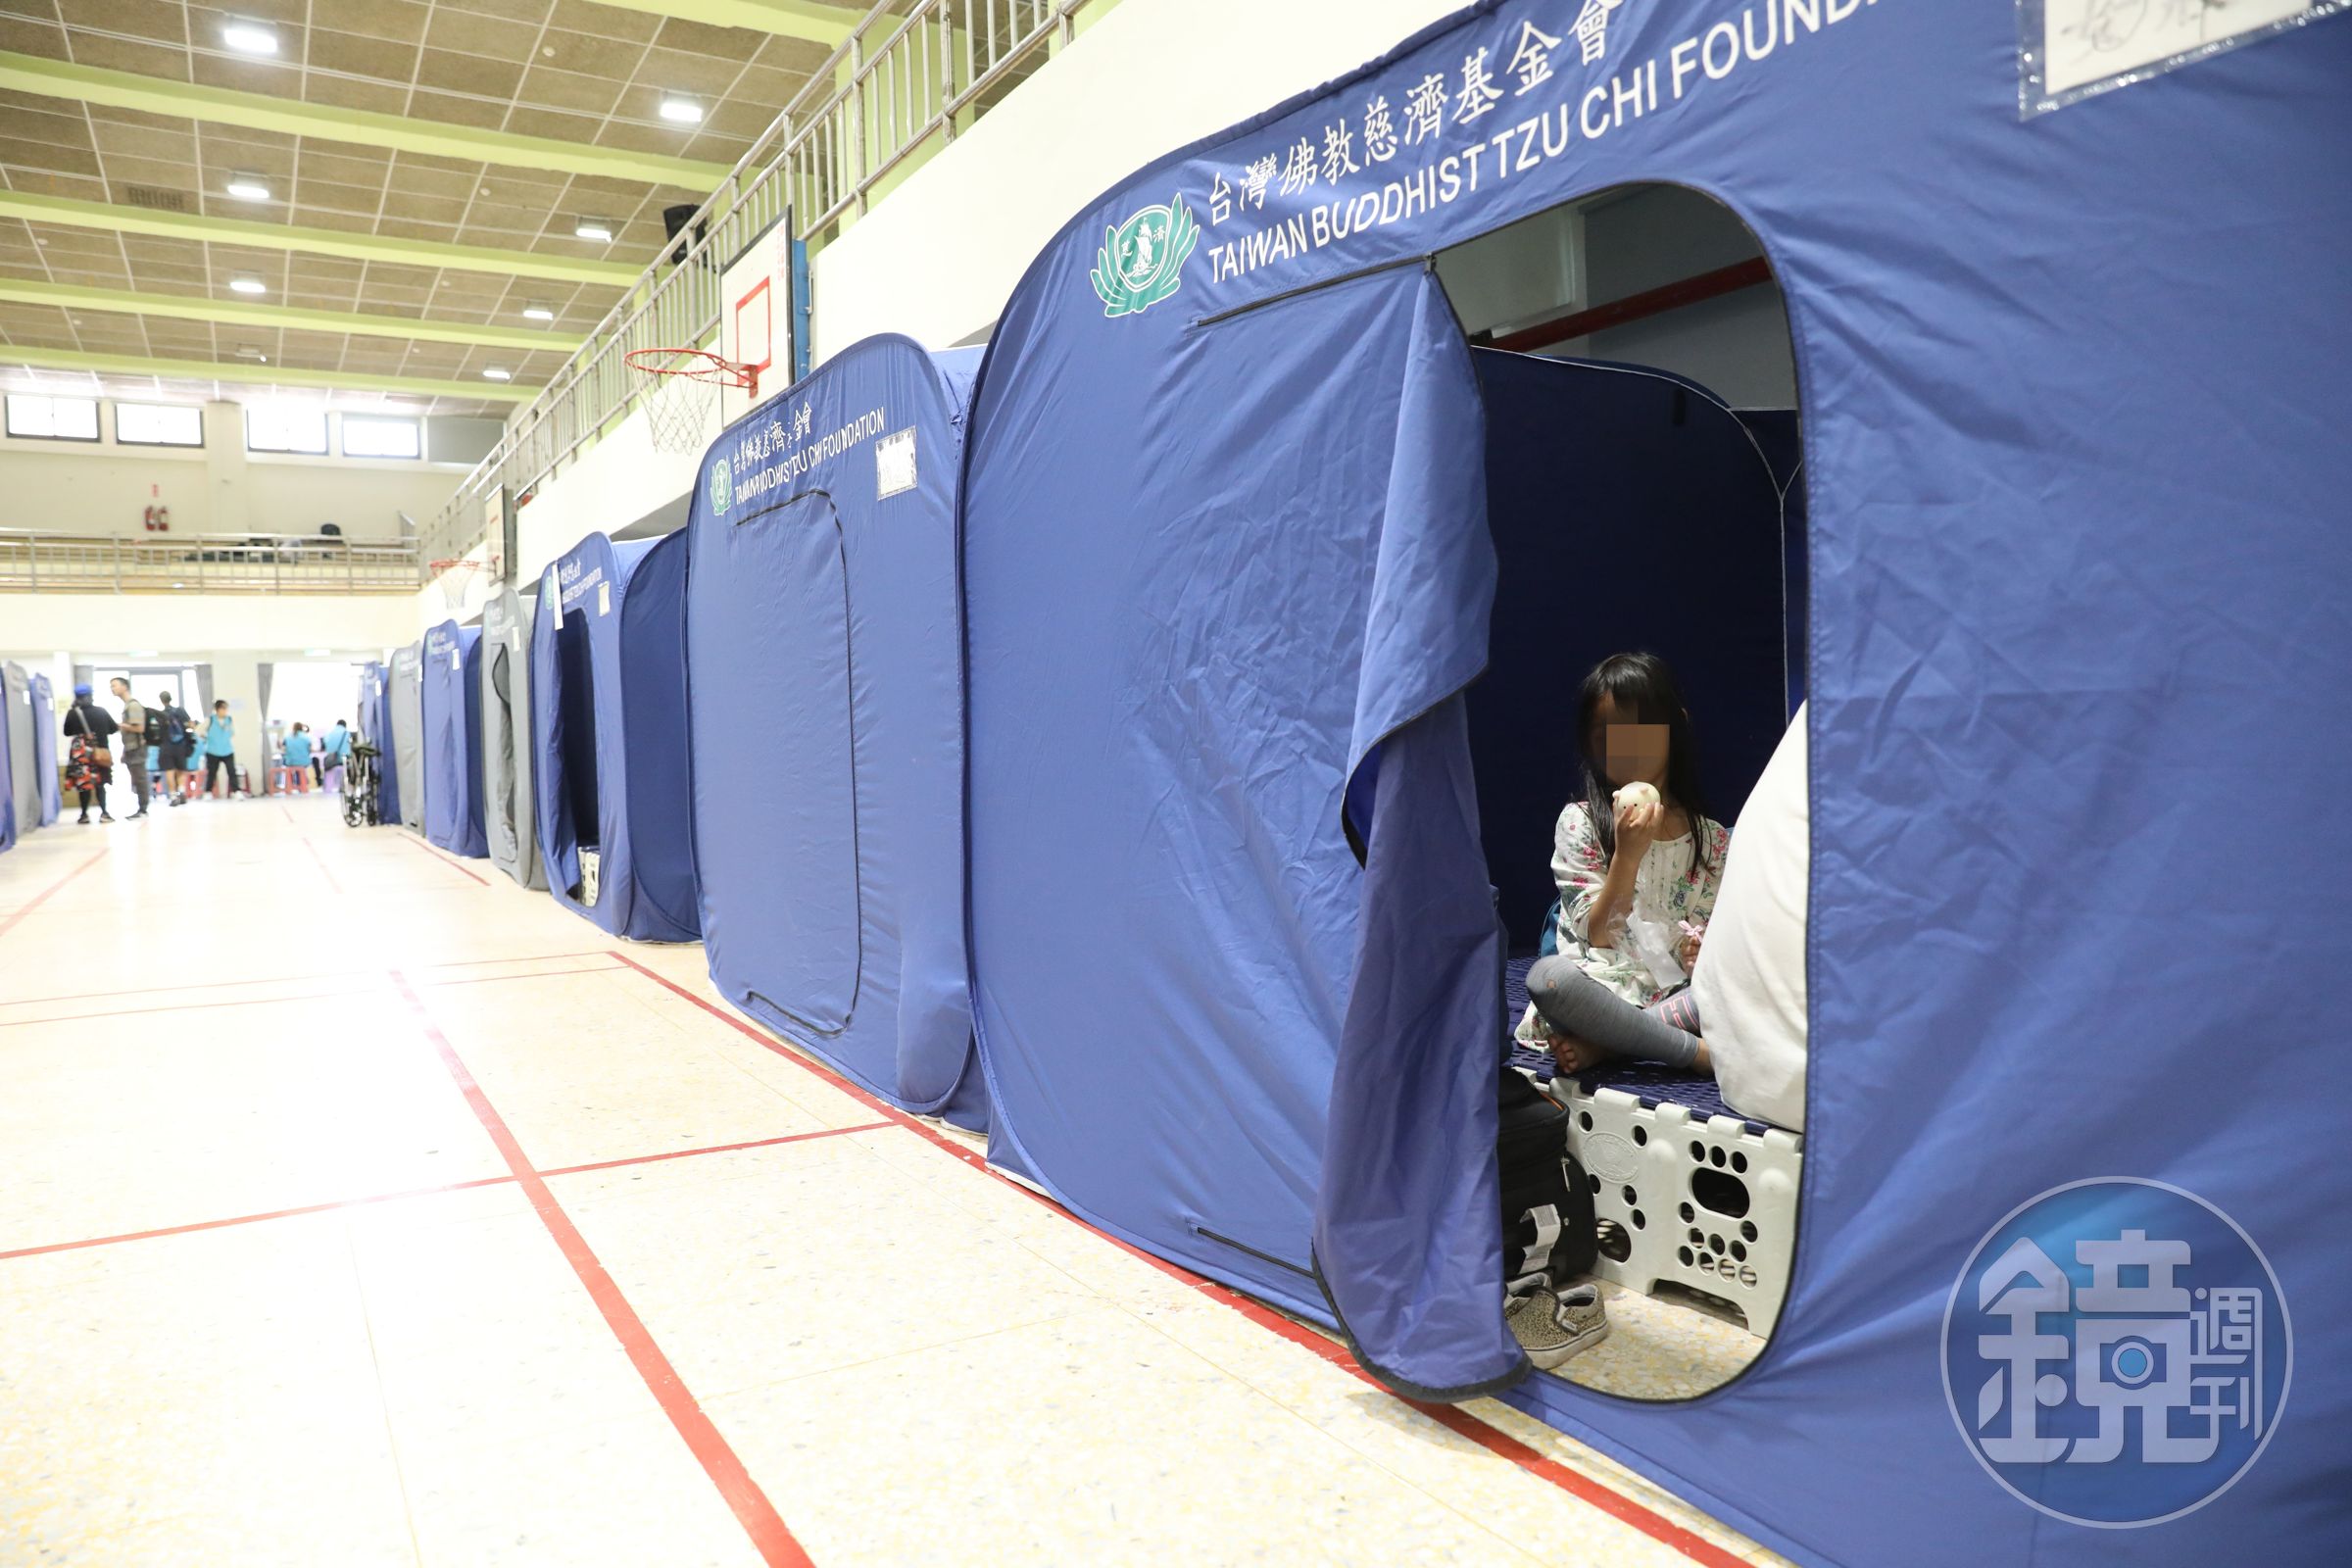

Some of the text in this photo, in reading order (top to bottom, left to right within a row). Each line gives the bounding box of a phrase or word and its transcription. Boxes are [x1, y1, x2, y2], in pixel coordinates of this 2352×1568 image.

[1207, 0, 1879, 284] TAIWAN BUDDHIST TZU CHI FOUN
[1208, 0, 1624, 226] 台灣佛教慈濟基金會
[808, 440, 823, 468] CHI
[822, 406, 885, 461] FOUNDATION
